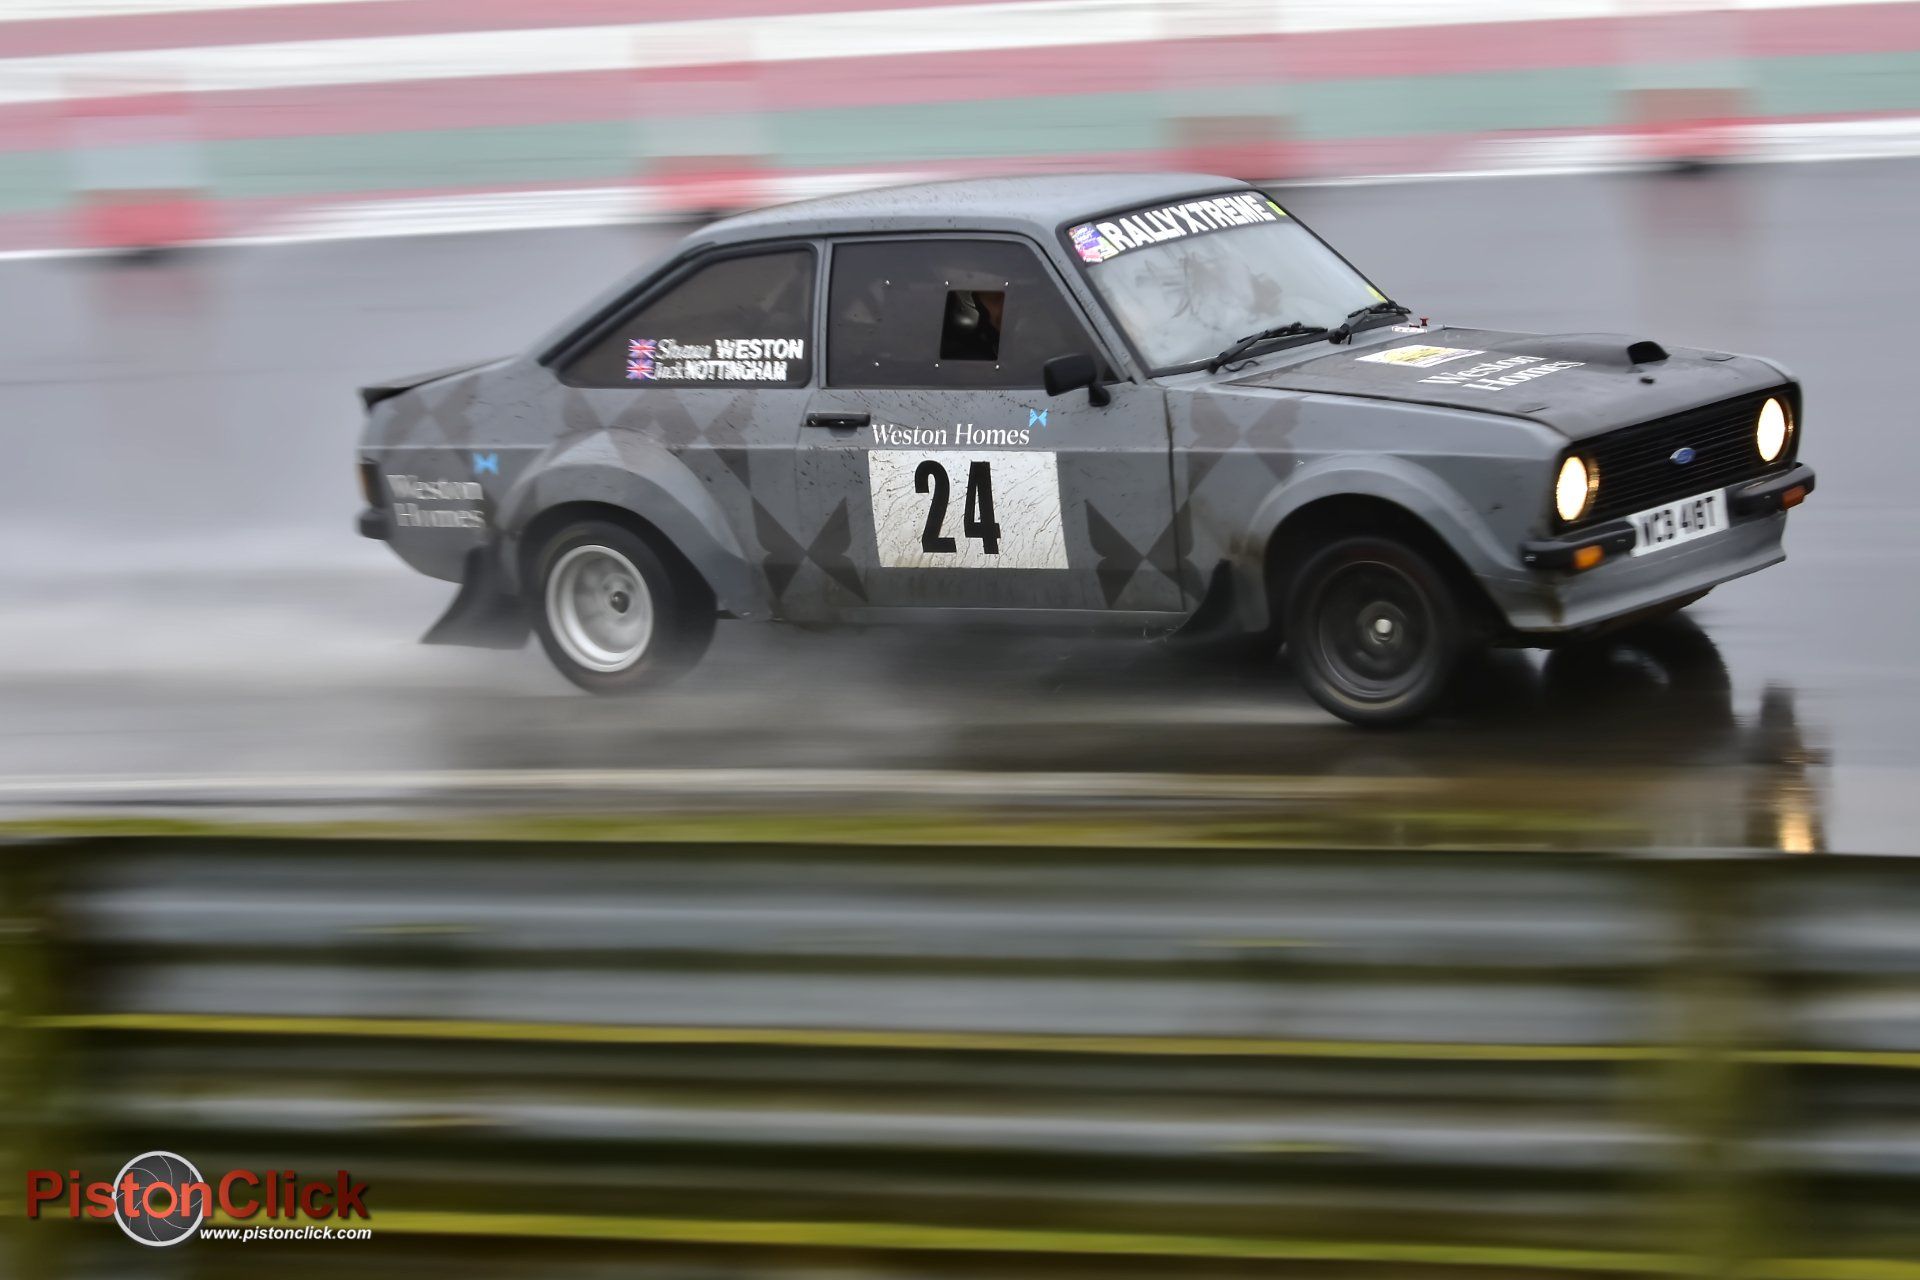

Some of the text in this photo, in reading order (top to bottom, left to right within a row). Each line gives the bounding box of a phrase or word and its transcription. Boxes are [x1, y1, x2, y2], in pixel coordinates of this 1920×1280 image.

[1096, 195, 1277, 251] RALLYXTREME
[715, 338, 804, 360] WESTON
[684, 360, 788, 381] NOTTINGHAM
[1417, 354, 1548, 384] Weston
[1462, 360, 1587, 391] Homes
[872, 423, 1030, 445] Weston Homes
[385, 474, 483, 500] Weston
[393, 502, 485, 528] Homes
[914, 459, 1002, 555] 24
